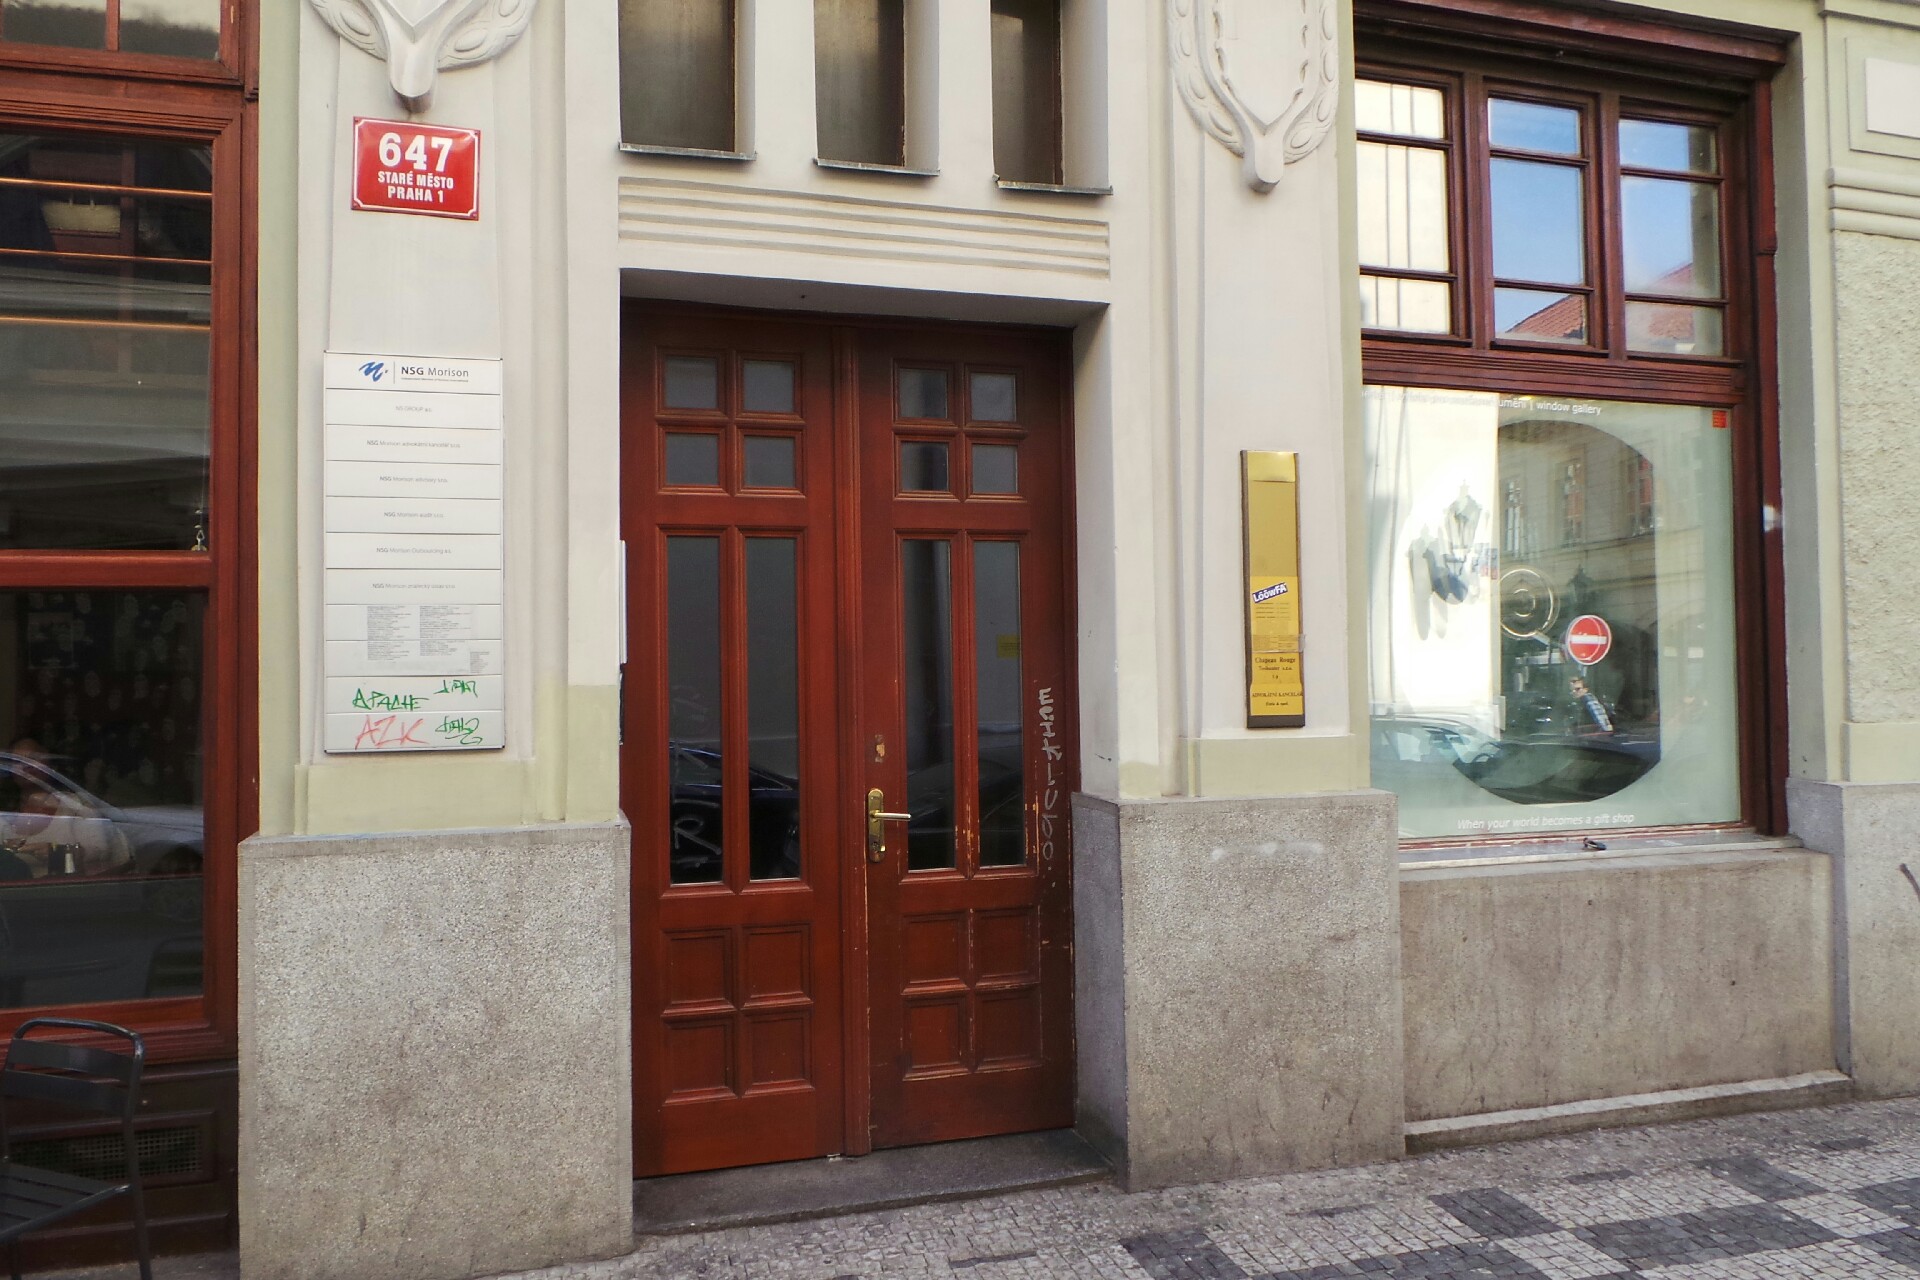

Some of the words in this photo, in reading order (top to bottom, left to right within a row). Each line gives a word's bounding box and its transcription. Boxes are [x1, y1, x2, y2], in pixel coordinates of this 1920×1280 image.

[379, 132, 453, 172] 647
[378, 171, 413, 186] STARÉ
[416, 173, 454, 189] MĚSTO
[387, 186, 433, 202] PRAHA
[437, 190, 444, 203] 1
[401, 366, 424, 376] NSG
[427, 367, 469, 378] Morison
[1536, 401, 1571, 412] window
[1572, 404, 1602, 416] gallery
[1457, 819, 1484, 829] When
[1487, 819, 1510, 831] your
[1512, 816, 1540, 828] world
[1542, 815, 1583, 826] becomes
[1585, 817, 1591, 825] a
[1594, 813, 1609, 826] gift
[1612, 813, 1635, 825] shop
